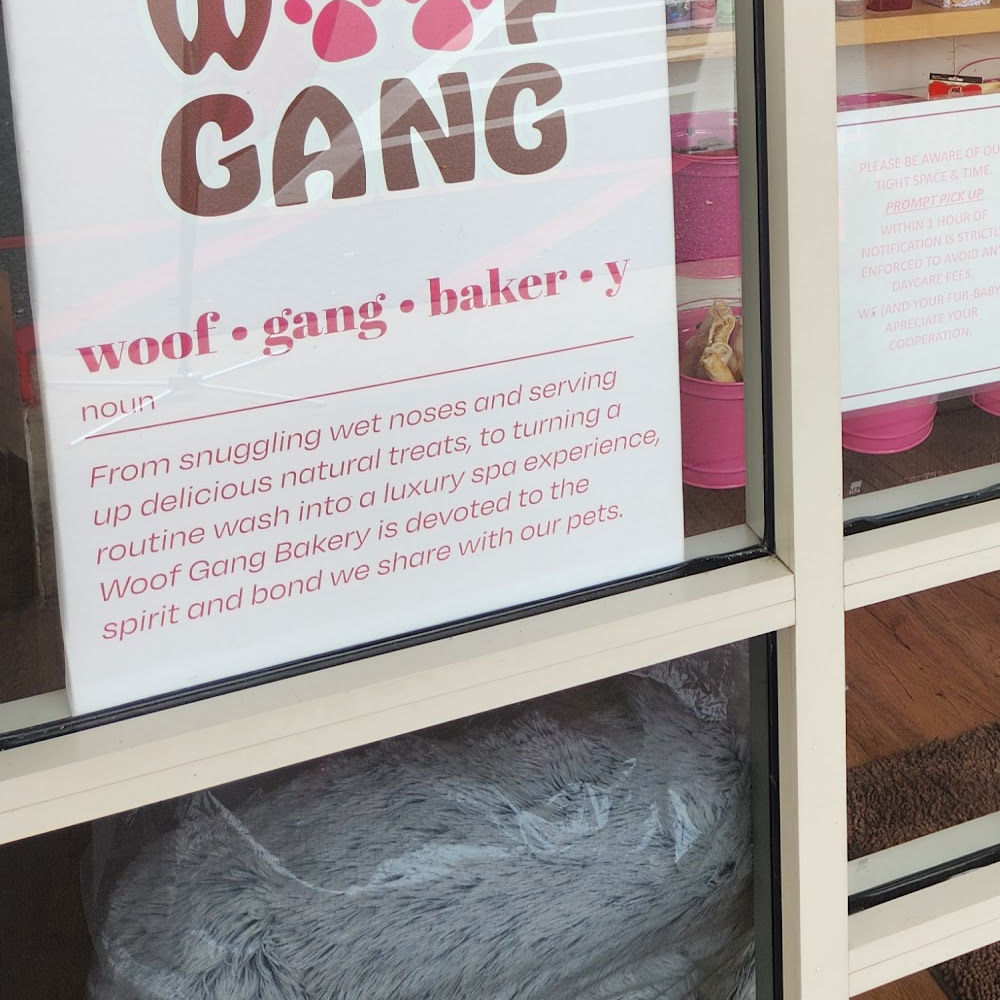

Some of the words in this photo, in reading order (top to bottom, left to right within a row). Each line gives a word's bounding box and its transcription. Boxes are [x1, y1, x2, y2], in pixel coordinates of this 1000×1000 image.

[161, 61, 568, 217] GANG
[860, 158, 901, 173] PLEASE
[905, 155, 919, 167] BE
[922, 149, 962, 165] AWARE
[965, 146, 980, 159] OF
[875, 177, 910, 191] TIGHT
[913, 171, 947, 186] SPACE
[950, 169, 959, 180] &
[962, 165, 992, 178] TIME.
[886, 195, 938, 213] PROMPT
[939, 190, 965, 206] PICK
[968, 188, 984, 201] UP
[881, 219, 923, 236] WITHIN
[937, 212, 970, 227] HOUR
[973, 209, 988, 221] OF
[861, 236, 942, 259] NOTIFICATION
[945, 233, 955, 245] IS
[861, 258, 923, 278] ENFORCED
[926, 255, 941, 267] TO
[944, 249, 979, 264] AVOID
[892, 273, 943, 292] DAYCARE
[946, 269, 974, 283] FEES.
[76, 311, 220, 373] woof
[262, 293, 388, 356] gang
[426, 267, 568, 317] baker
[604, 258, 630, 297] y
[858, 307, 877, 320] WE
[880, 301, 910, 317] (AND
[913, 295, 944, 309] YOUR
[884, 313, 945, 334] APRECIATE
[948, 307, 978, 321] YOUR
[889, 327, 973, 351] COOPERATION.
[81, 395, 155, 422] noun
[90, 458, 170, 488] From
[179, 428, 321, 471] snuggling
[330, 413, 382, 442] wet
[389, 400, 467, 428] noses
[474, 384, 523, 413] and
[528, 370, 617, 402] serving
[93, 503, 132, 528] up
[140, 475, 272, 517] delicious
[281, 448, 381, 488] natural
[389, 436, 472, 467] treats,
[480, 427, 505, 447] to
[513, 408, 600, 440] turning
[606, 403, 621, 420] a
[96, 527, 205, 565] routine
[213, 505, 290, 540] wash
[299, 495, 352, 522] into
[359, 490, 376, 508] a
[383, 471, 465, 504] luxury
[471, 460, 517, 485] spa
[523, 429, 660, 471] experience,
[100, 563, 182, 602] Woof
[188, 550, 266, 583] Gang
[275, 527, 371, 563] Bakery
[378, 520, 398, 540] is
[405, 491, 512, 533] devoted
[518, 488, 543, 508] to
[550, 478, 589, 500] the
[102, 604, 180, 641] spirit
[187, 587, 243, 620] and
[251, 569, 323, 605] bond
[330, 563, 370, 587] we
[377, 544, 451, 576] share
[458, 526, 513, 556] with
[520, 518, 561, 542] our
[566, 503, 623, 534] pets.
